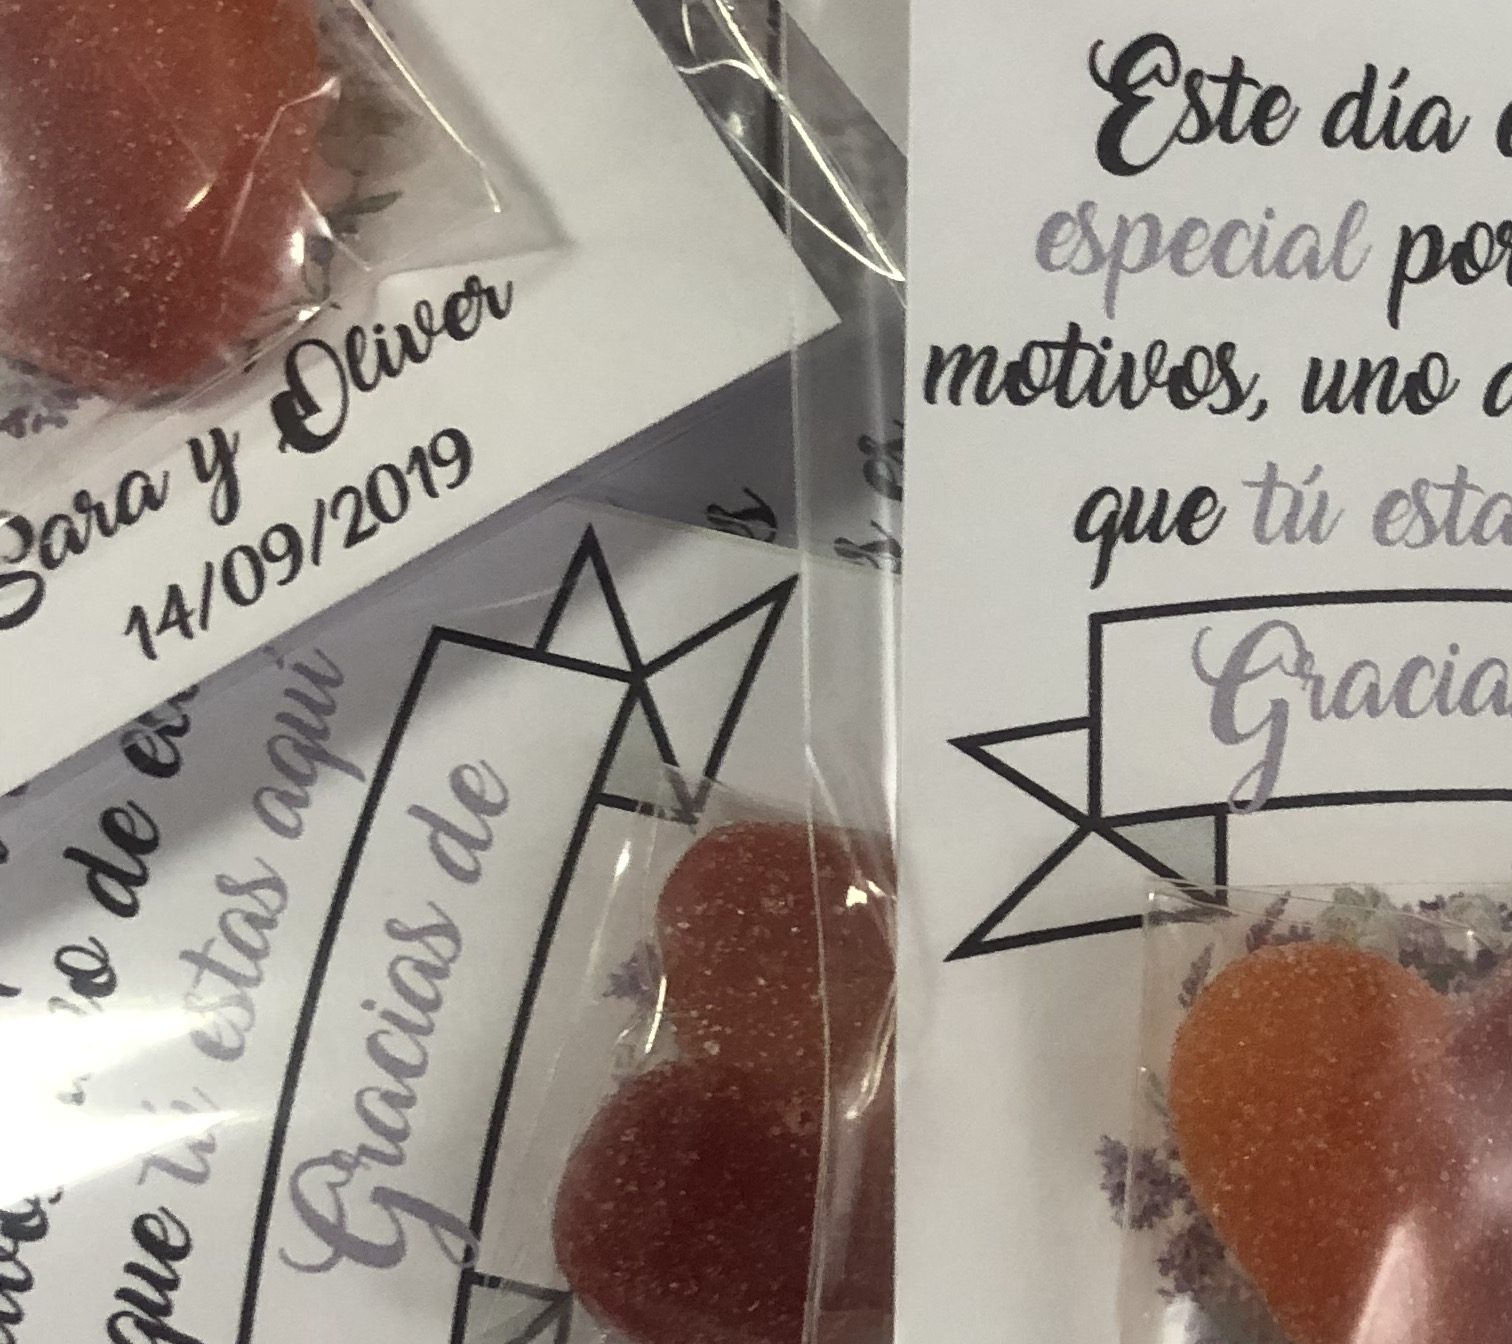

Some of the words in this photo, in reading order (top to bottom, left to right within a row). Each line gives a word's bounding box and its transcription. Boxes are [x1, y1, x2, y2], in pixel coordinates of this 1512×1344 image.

[1088, 31, 1299, 176] Este
[1321, 63, 1470, 157] día
[1034, 198, 1372, 319] especial
[186, 428, 241, 526] y
[270, 274, 516, 455] Oliver
[922, 322, 1270, 423] motivos,
[1300, 350, 1461, 415] uno
[125, 426, 473, 660] 14/09/2019
[1072, 482, 1226, 590] que
[1240, 460, 1344, 548] tú
[62, 799, 160, 919] de
[179, 857, 289, 1063] estas
[252, 644, 367, 841] aquí
[277, 898, 481, 1274] Gracias
[407, 759, 510, 885] de
